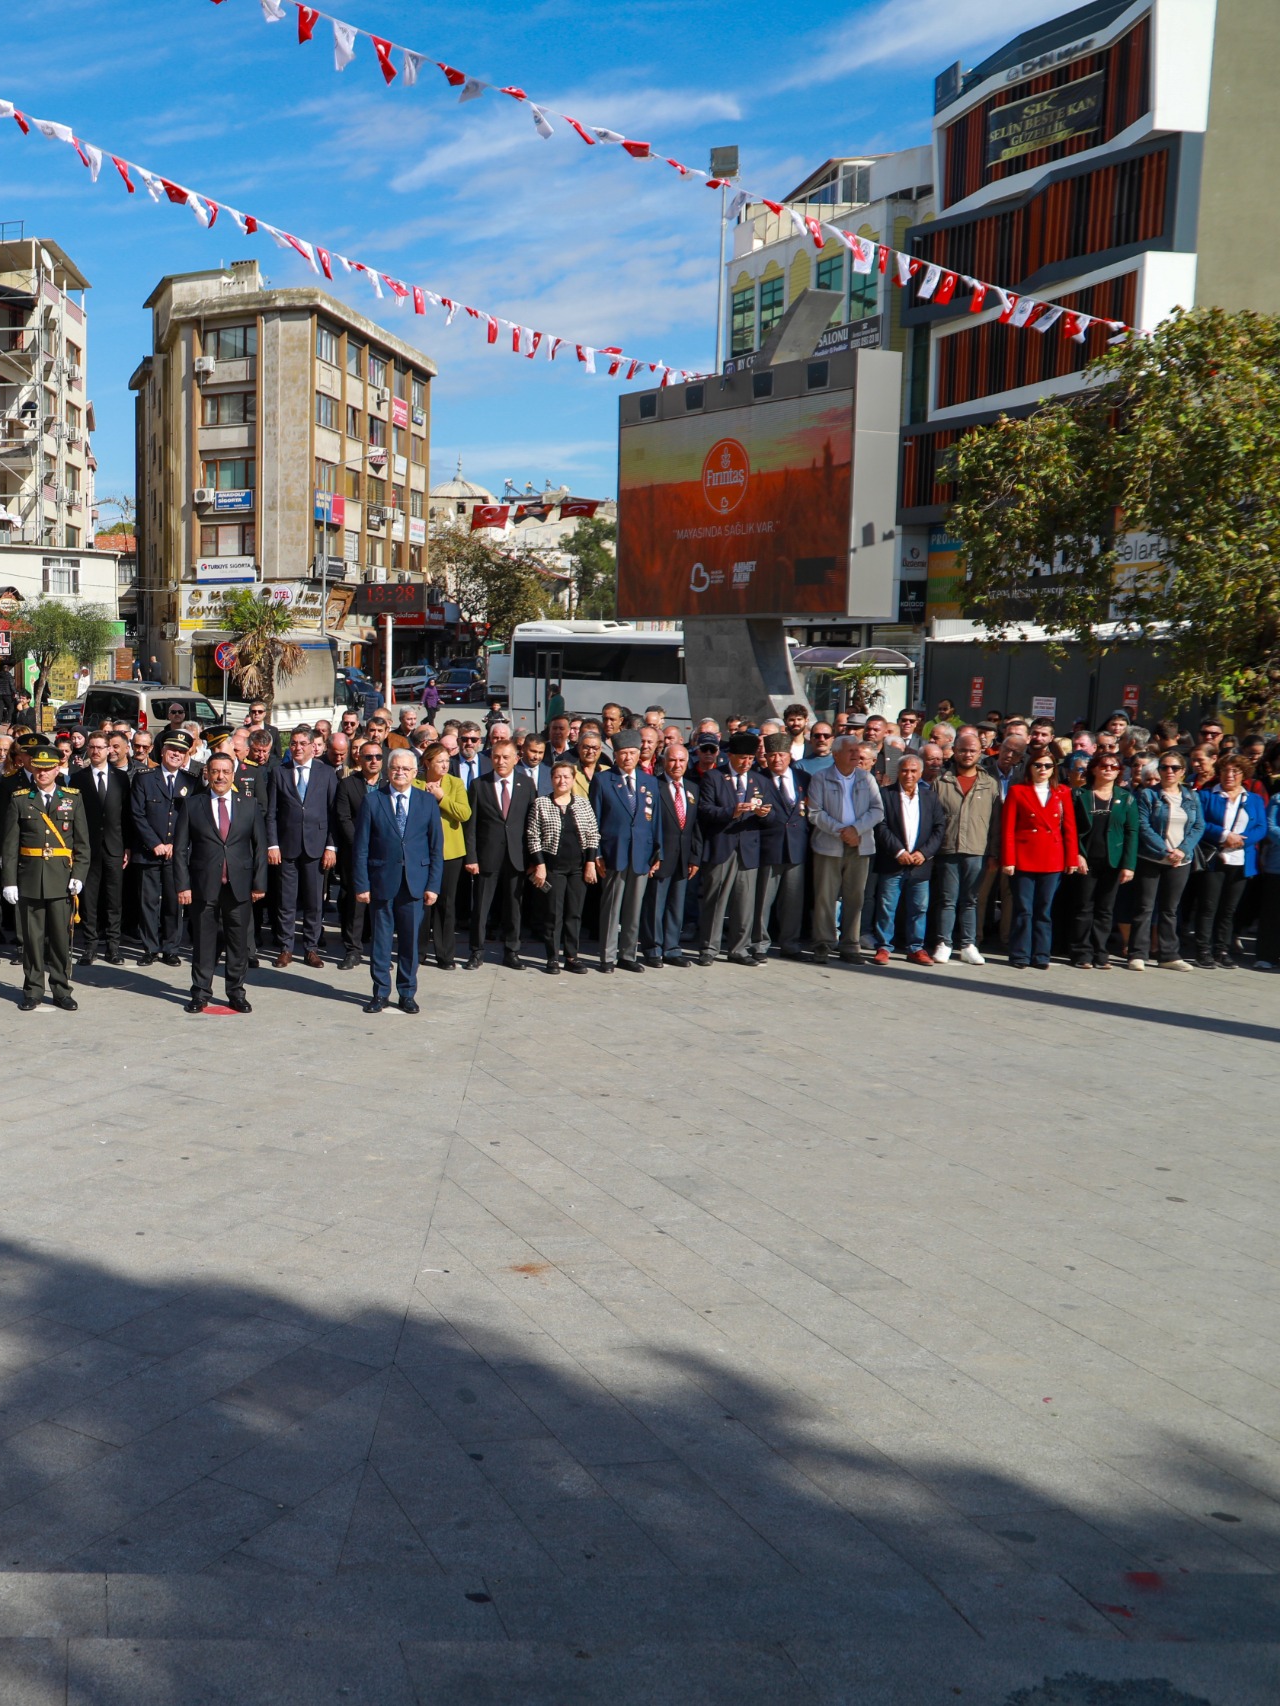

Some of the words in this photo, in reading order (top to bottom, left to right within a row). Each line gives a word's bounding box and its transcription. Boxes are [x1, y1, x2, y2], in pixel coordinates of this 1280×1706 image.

[989, 121, 1023, 143] SELİN
[1025, 107, 1067, 130] BESTE
[1066, 95, 1097, 116] KAN
[1010, 120, 1067, 146] GÜZELLİK
[724, 520, 755, 537] SAĞLIK
[274, 591, 290, 600] OTEL
[366, 585, 415, 603] 13:28
